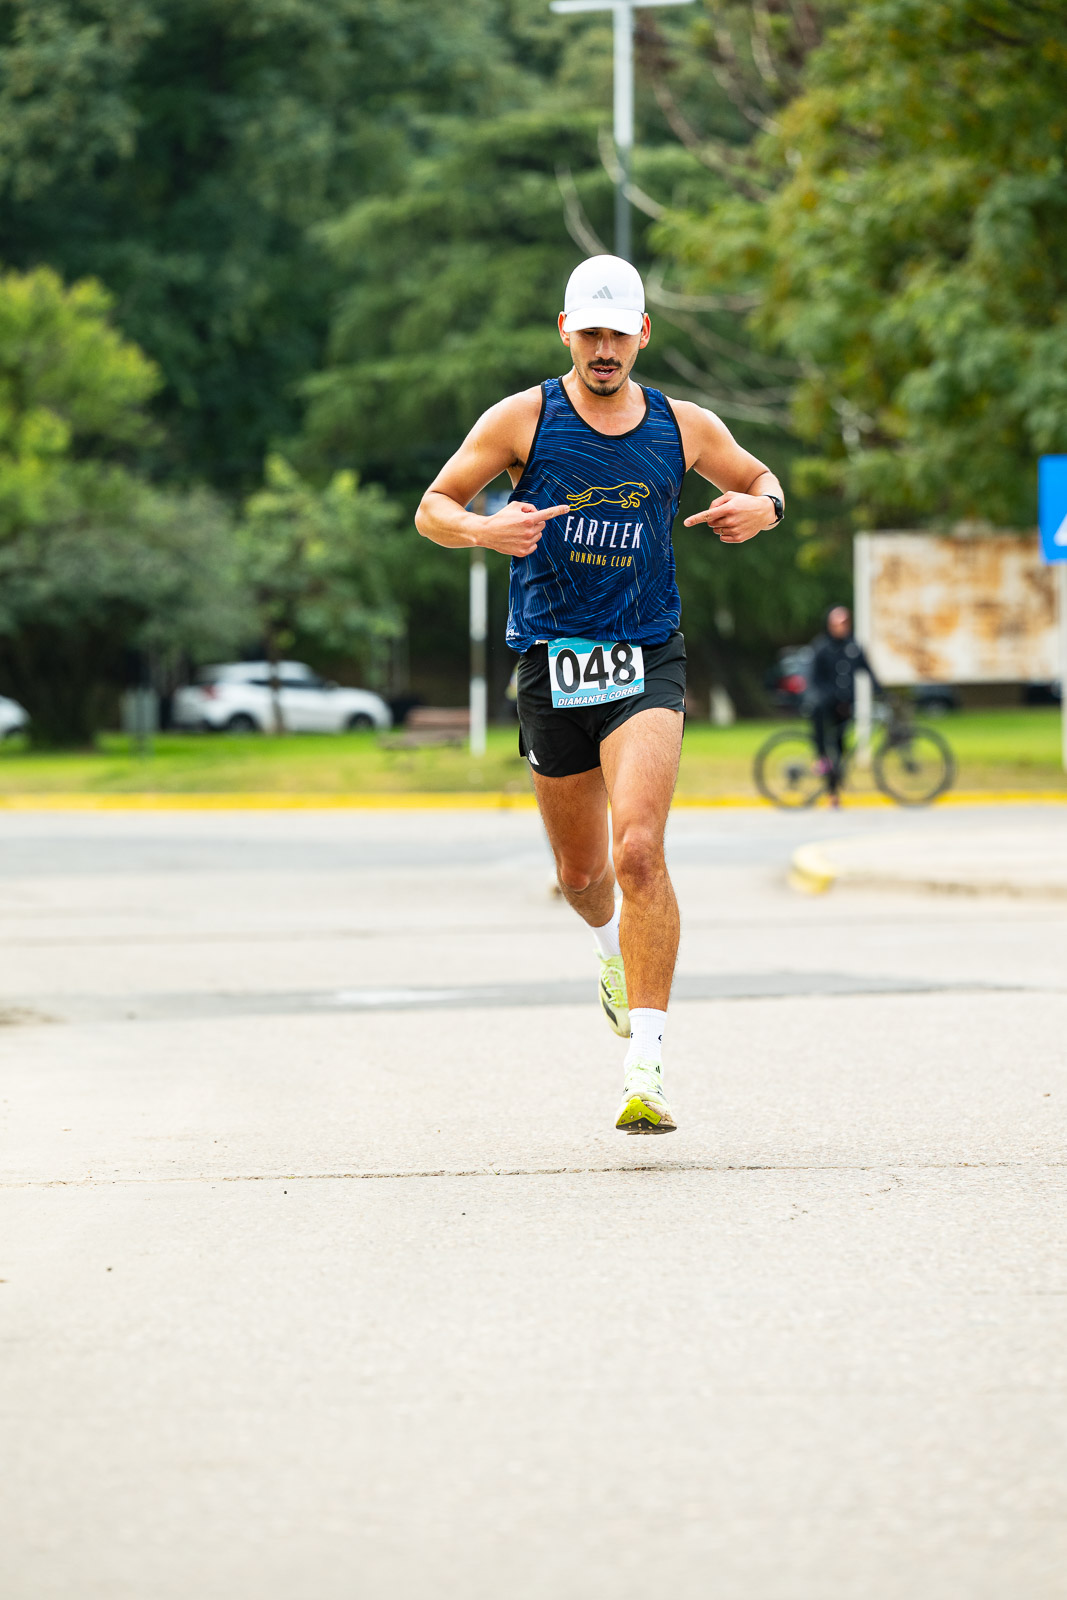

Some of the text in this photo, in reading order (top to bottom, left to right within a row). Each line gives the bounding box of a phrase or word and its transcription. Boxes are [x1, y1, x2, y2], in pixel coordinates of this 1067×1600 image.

[564, 515, 644, 549] FARTLEK
[569, 550, 633, 567] RUNNING CLUB
[555, 642, 637, 695] 048
[557, 685, 640, 707] DIAMANTE CORRE
